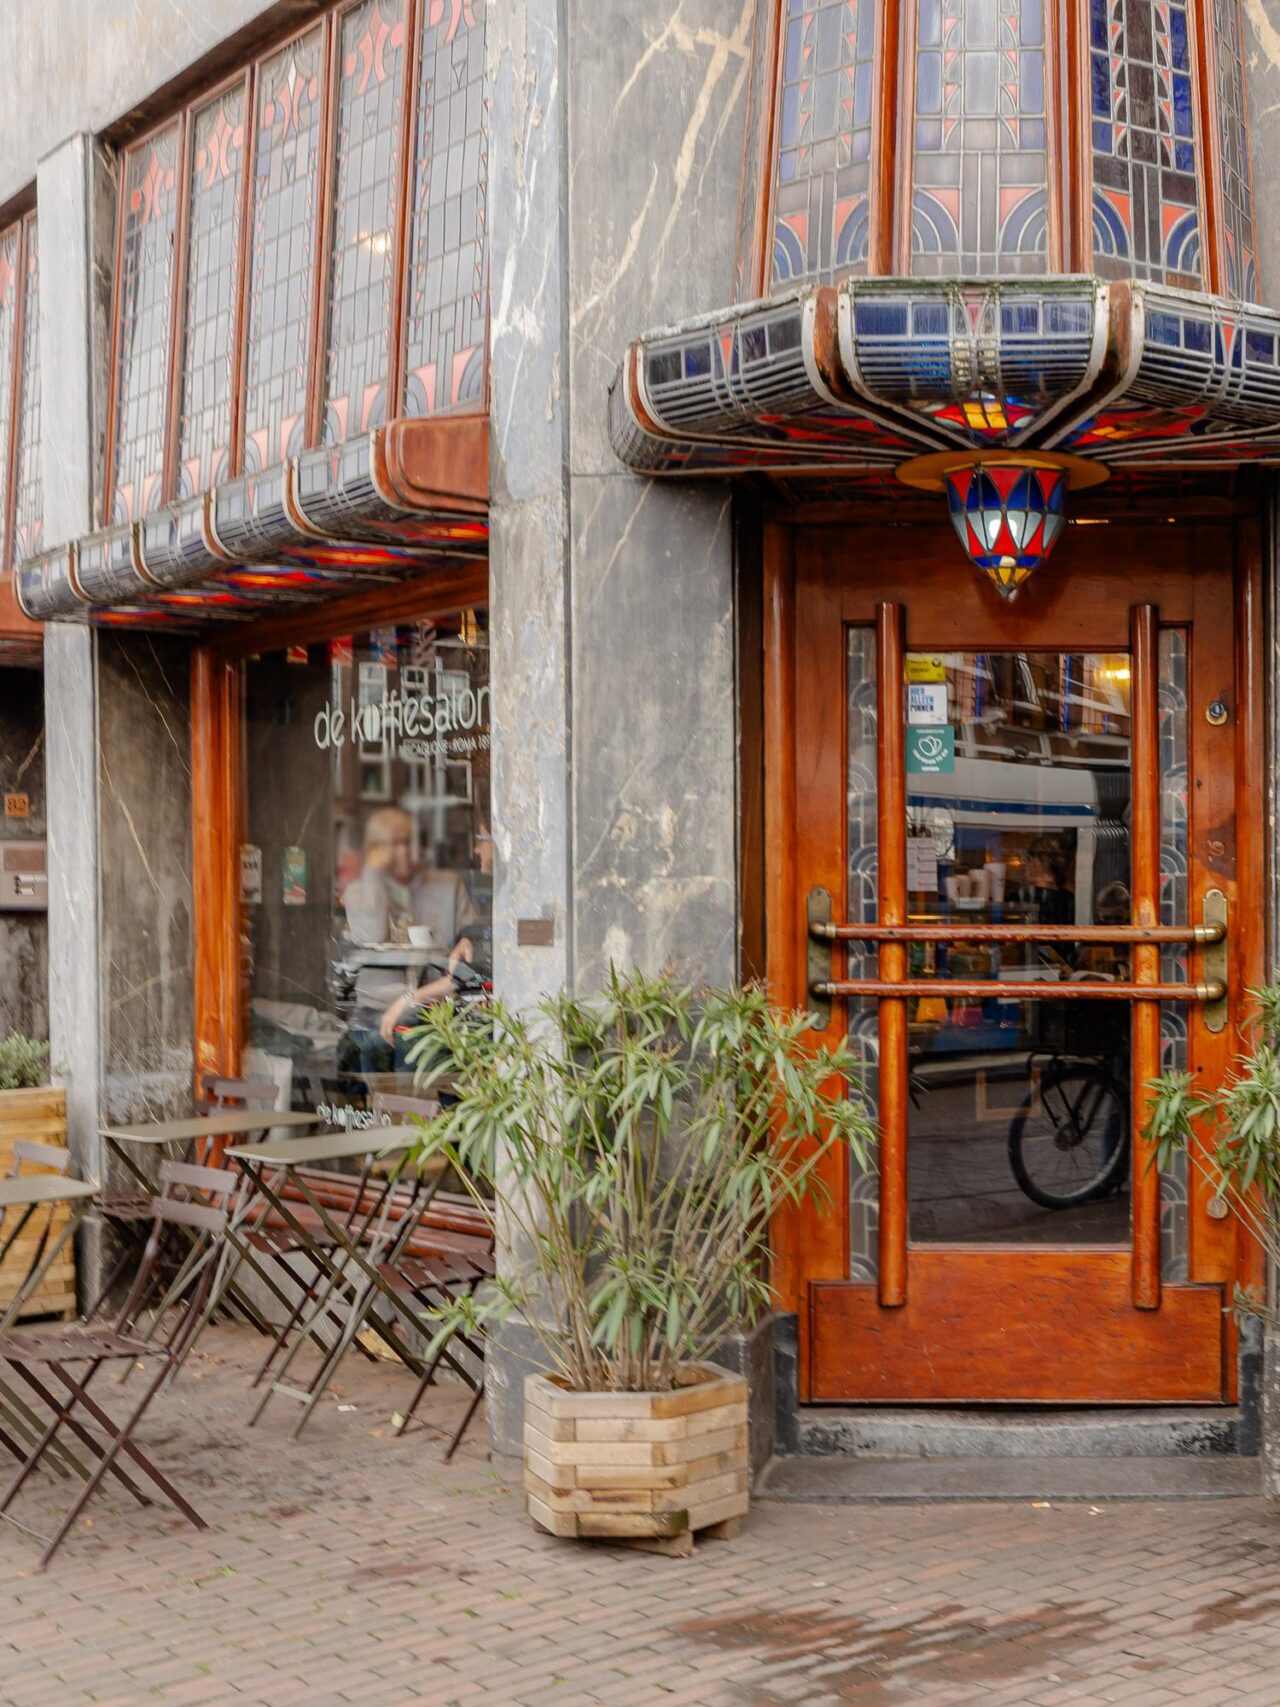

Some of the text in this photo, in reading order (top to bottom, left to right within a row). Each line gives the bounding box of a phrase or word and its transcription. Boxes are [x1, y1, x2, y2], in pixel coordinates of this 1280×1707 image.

[314, 700, 345, 750] de
[453, 737, 477, 752] ROMA
[316, 1101, 332, 1125] de
